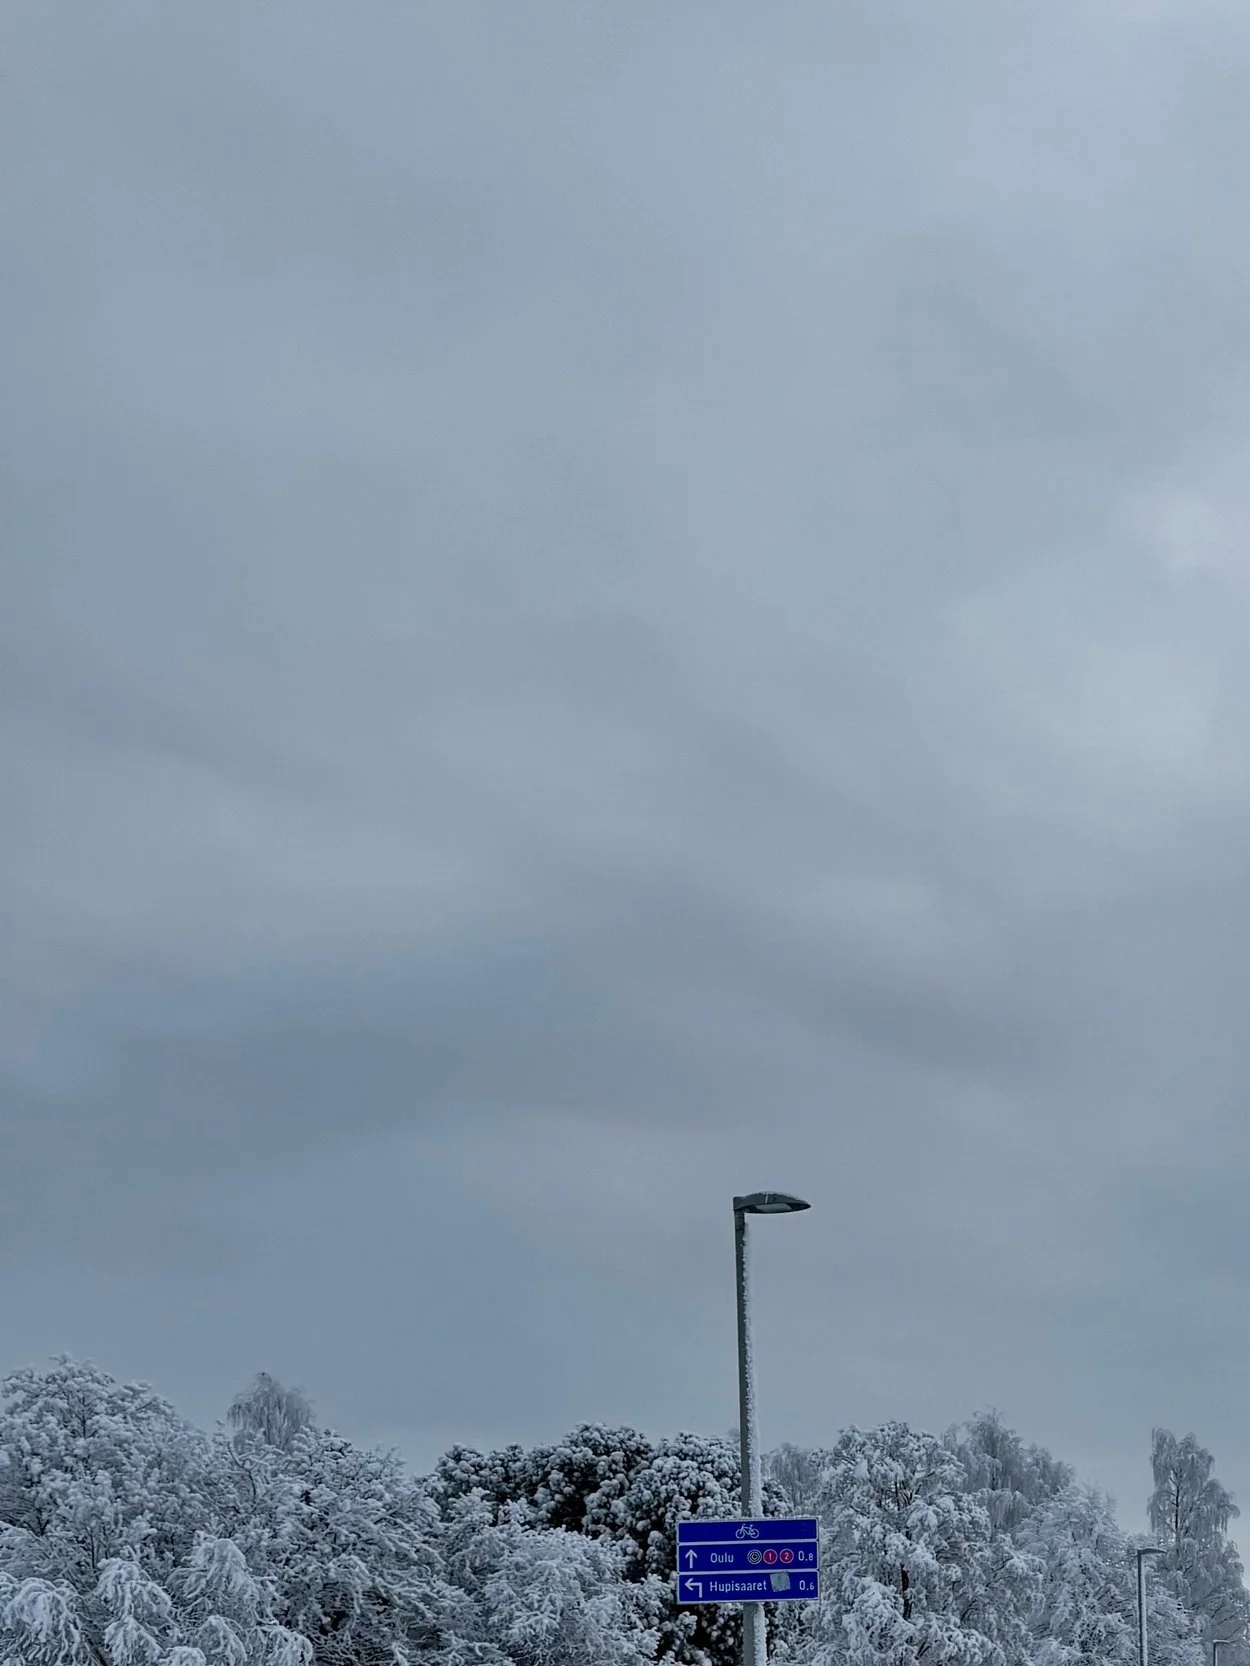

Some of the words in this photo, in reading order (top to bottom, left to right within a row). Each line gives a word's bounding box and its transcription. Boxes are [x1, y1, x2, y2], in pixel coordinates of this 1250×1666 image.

[710, 1552, 734, 1563] Oulu
[798, 1550, 814, 1562] 0.8
[709, 1579, 767, 1593] Hupisaaret
[799, 1579, 815, 1591] 0.6
